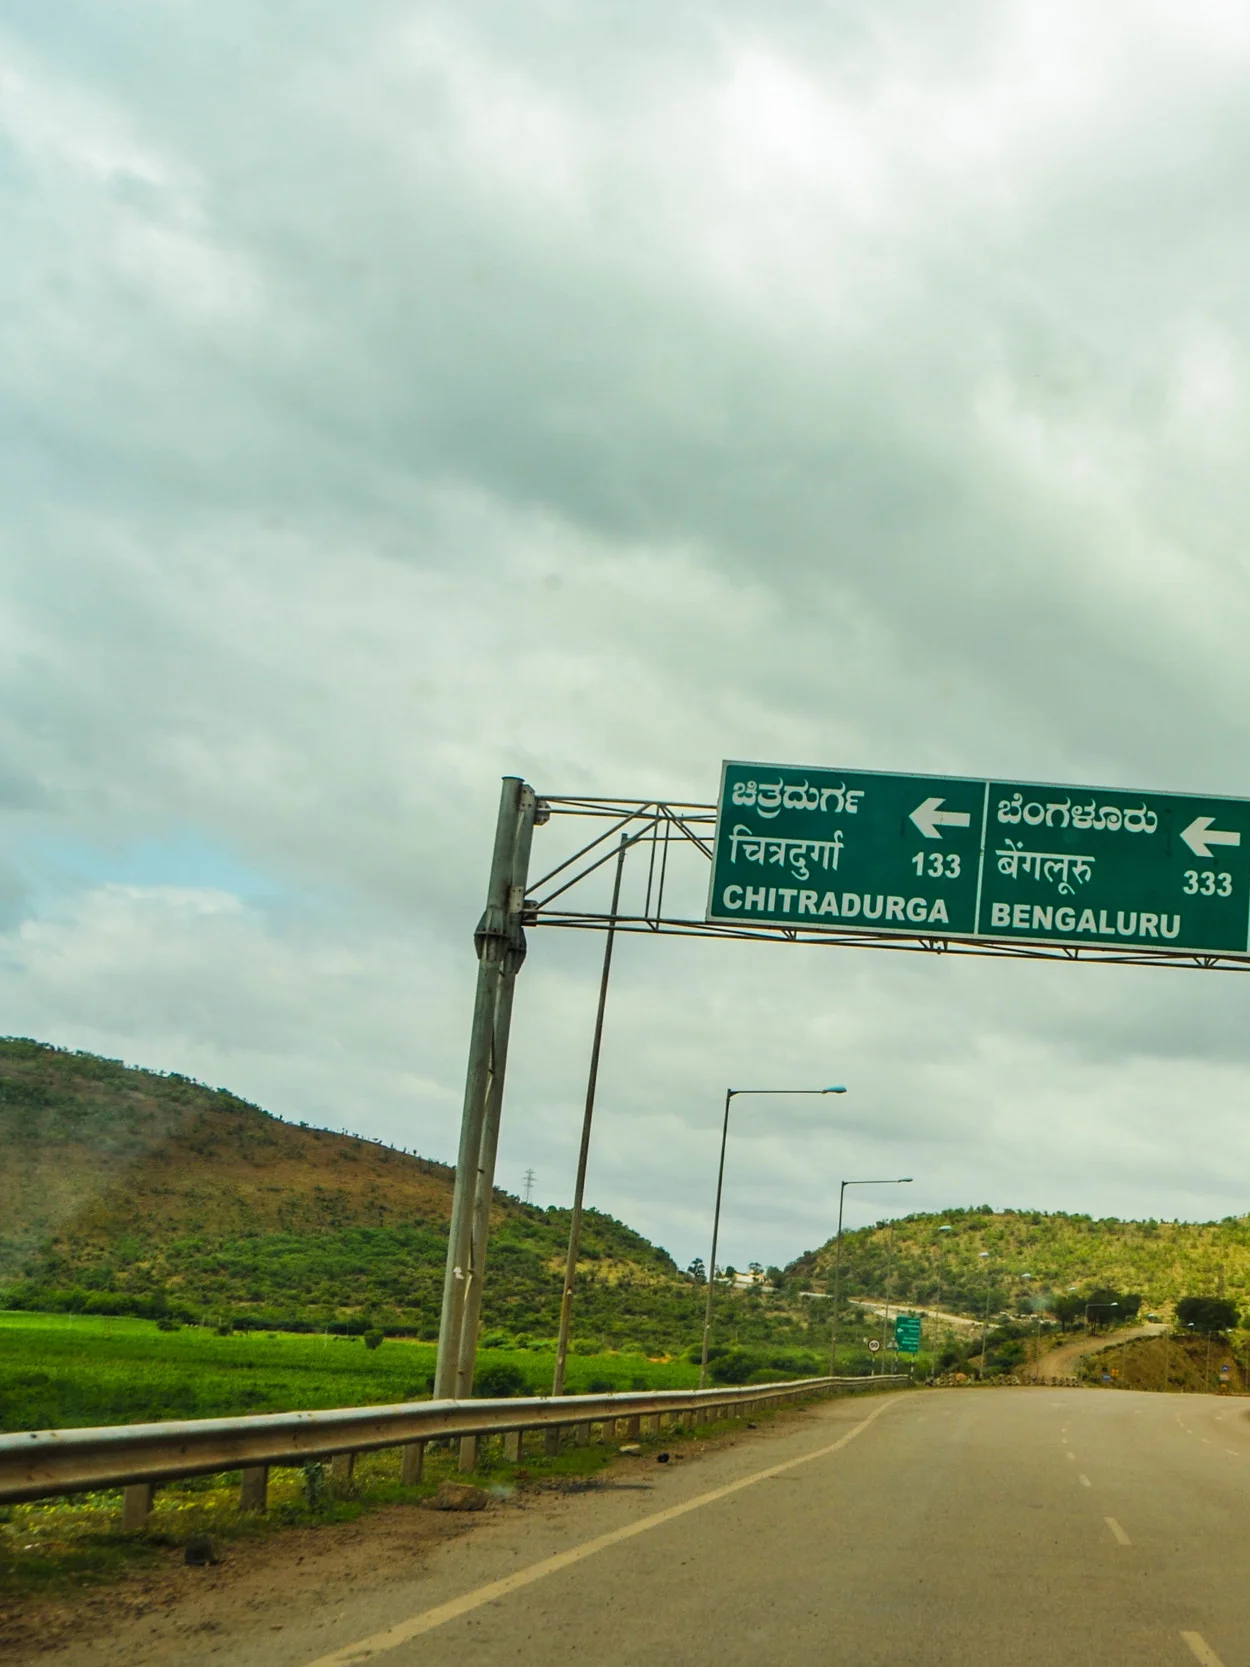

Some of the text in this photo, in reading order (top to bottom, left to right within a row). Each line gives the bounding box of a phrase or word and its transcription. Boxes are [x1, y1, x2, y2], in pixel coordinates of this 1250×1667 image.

[732, 778, 865, 819] ಚಿತ್ರದುರ್ಗ
[997, 792, 1158, 834] ಬೆಂಗಳೂರು
[729, 824, 844, 881] चित्रदुर्गा
[912, 851, 961, 879] 133
[995, 838, 1095, 895] बेंगलूरु
[723, 884, 949, 923] CHITRADURGA
[1183, 870, 1233, 897] 333
[991, 902, 1181, 939] BENGALURU
